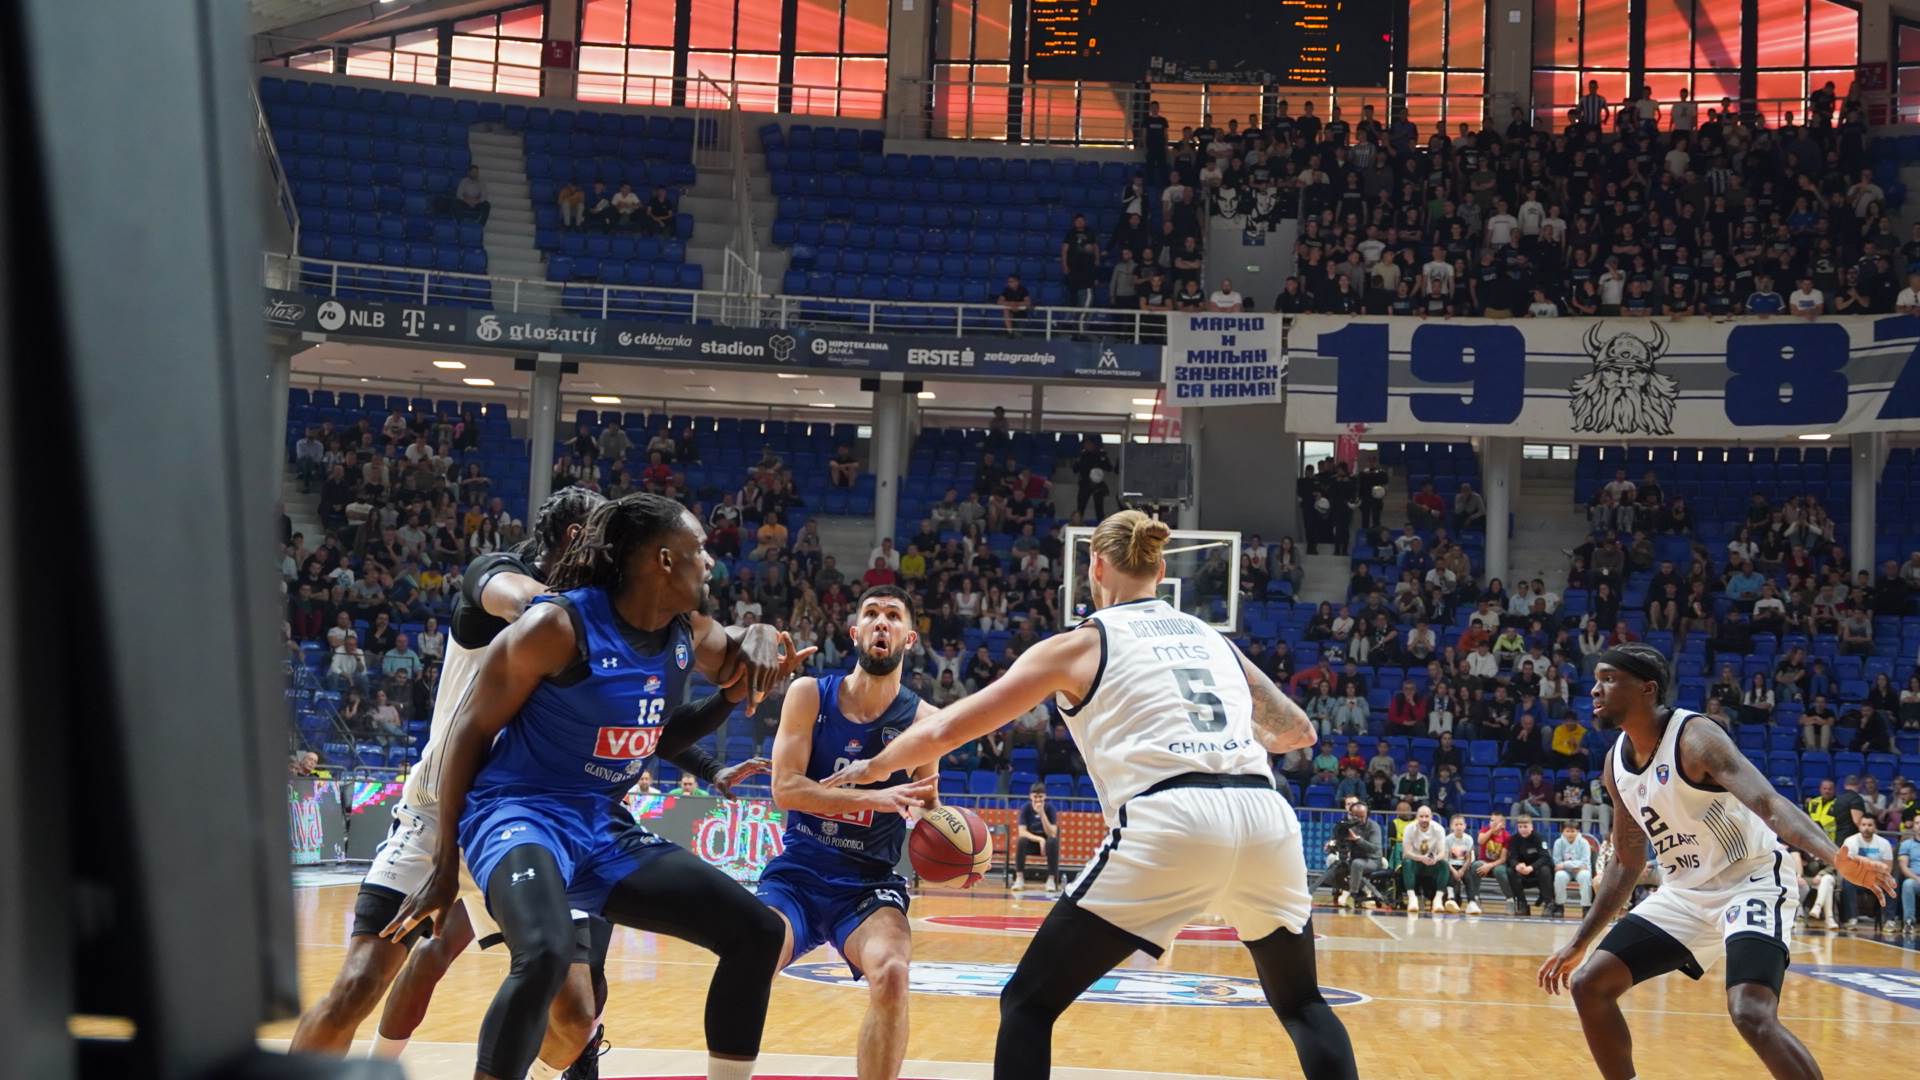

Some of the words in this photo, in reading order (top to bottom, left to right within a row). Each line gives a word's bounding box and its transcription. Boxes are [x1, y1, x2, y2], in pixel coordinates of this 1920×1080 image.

[350, 309, 385, 328] NLB
[402, 309, 425, 337] T
[1190, 317, 1264, 331] МАРКО
[509, 324, 598, 346] glosarij
[634, 332, 693, 348] ckbbanka
[701, 340, 765, 357] stadion
[828, 340, 889, 351] HIPOTEKARNA
[907, 348, 960, 366] ERSTE
[984, 351, 1056, 366] zetagradnja
[1176, 383, 1204, 398] СА
[1210, 382, 1276, 398] НАМА!
[1152, 642, 1210, 661] mts
[1171, 668, 1228, 732] 5
[584, 762, 612, 781] GLAVNI
[1640, 806, 1669, 838] 2
[831, 837, 865, 851] PODGORICA
[1746, 898, 1768, 929] 2
